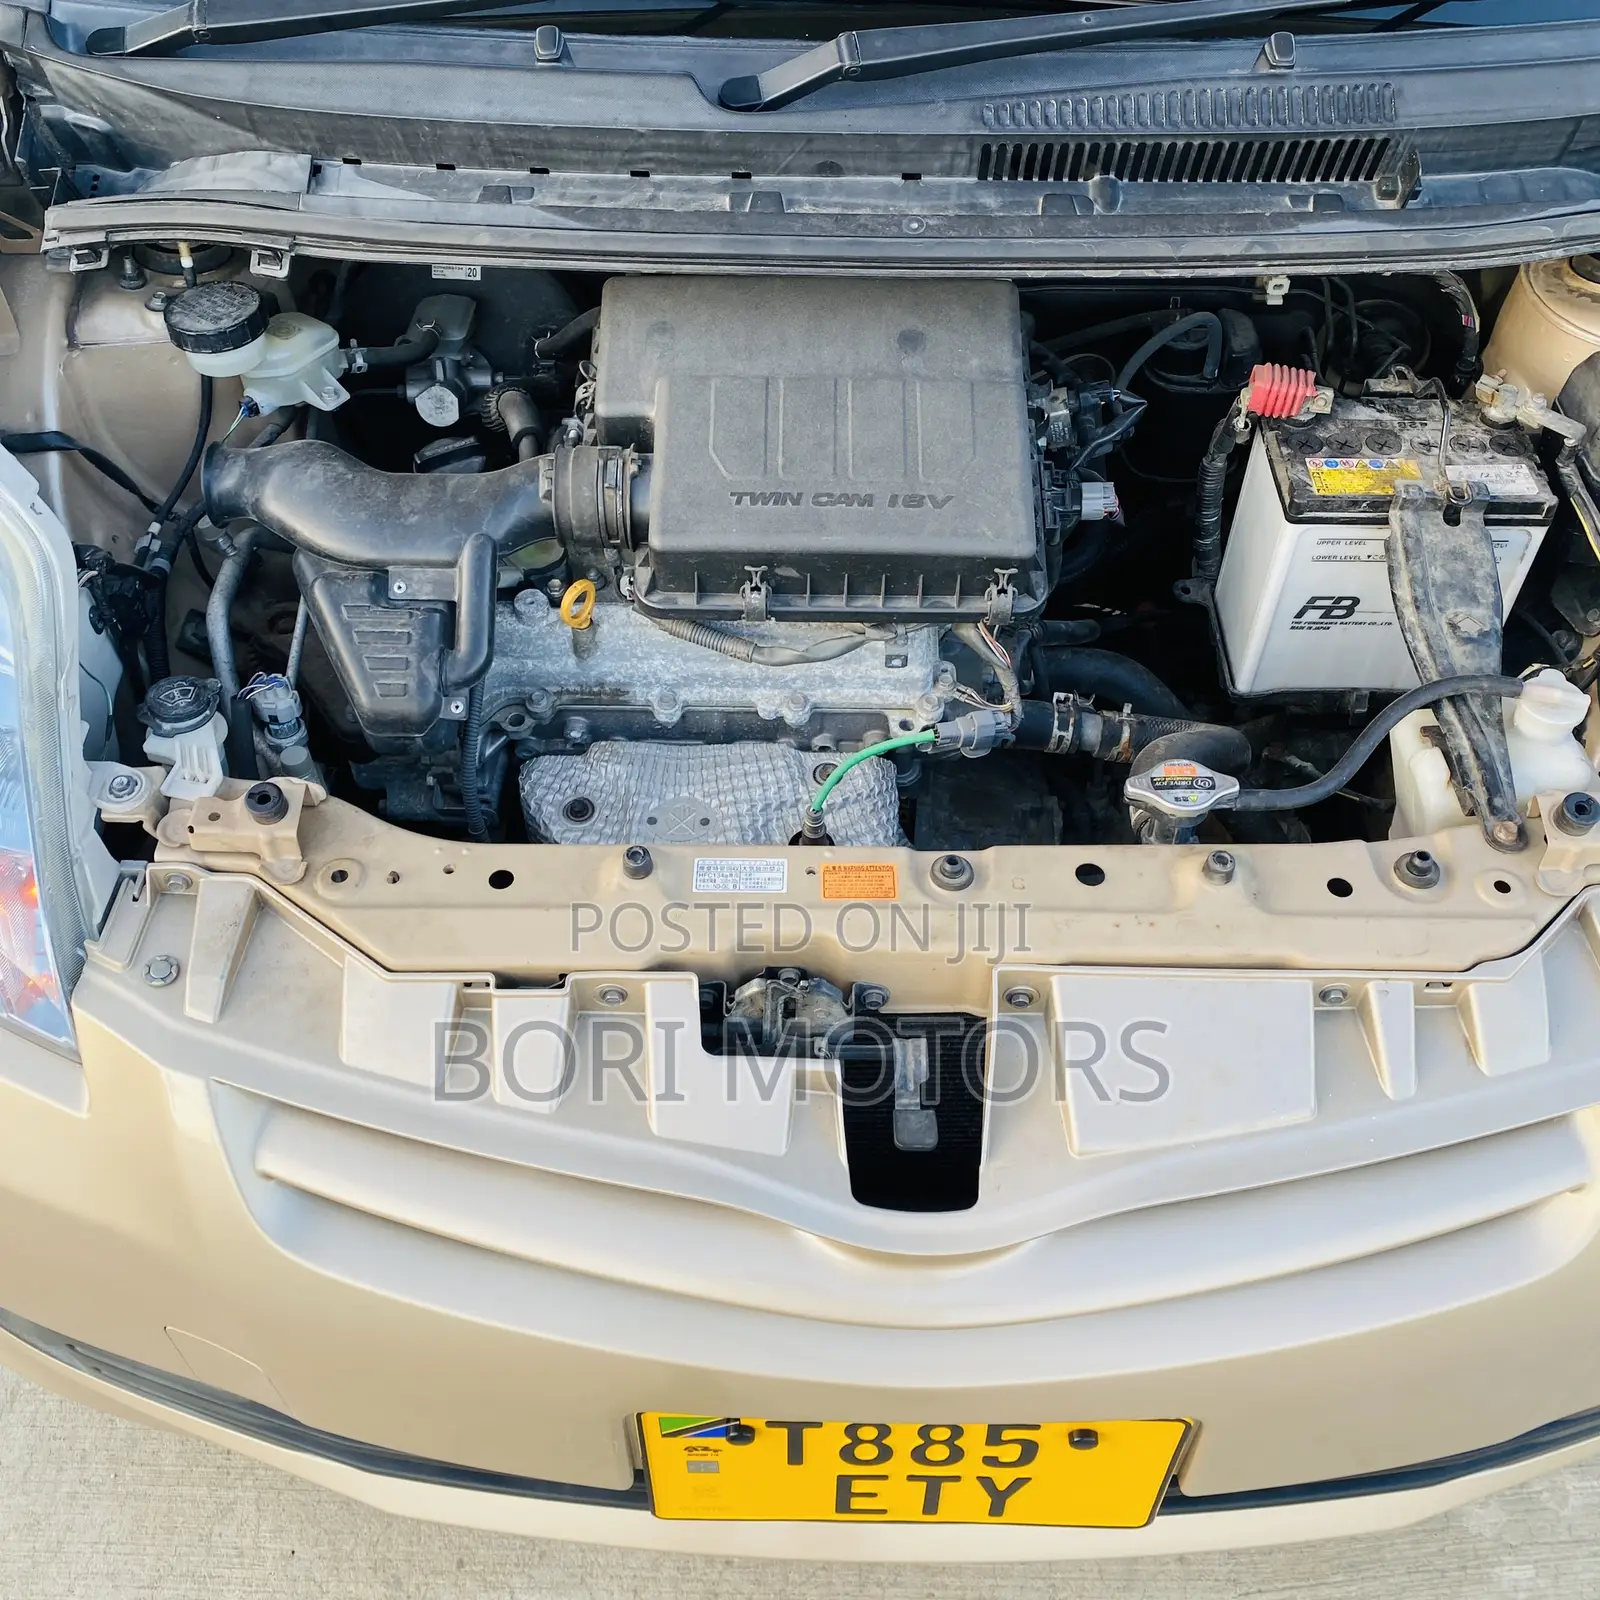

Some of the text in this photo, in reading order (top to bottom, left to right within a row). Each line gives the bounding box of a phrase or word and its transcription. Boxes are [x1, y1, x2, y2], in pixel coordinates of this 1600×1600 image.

[467, 267, 478, 277] 20
[729, 491, 804, 507] TWIN
[811, 492, 874, 508] CAM
[1293, 596, 1361, 620] FB
[834, 1474, 1033, 1517] ETY
